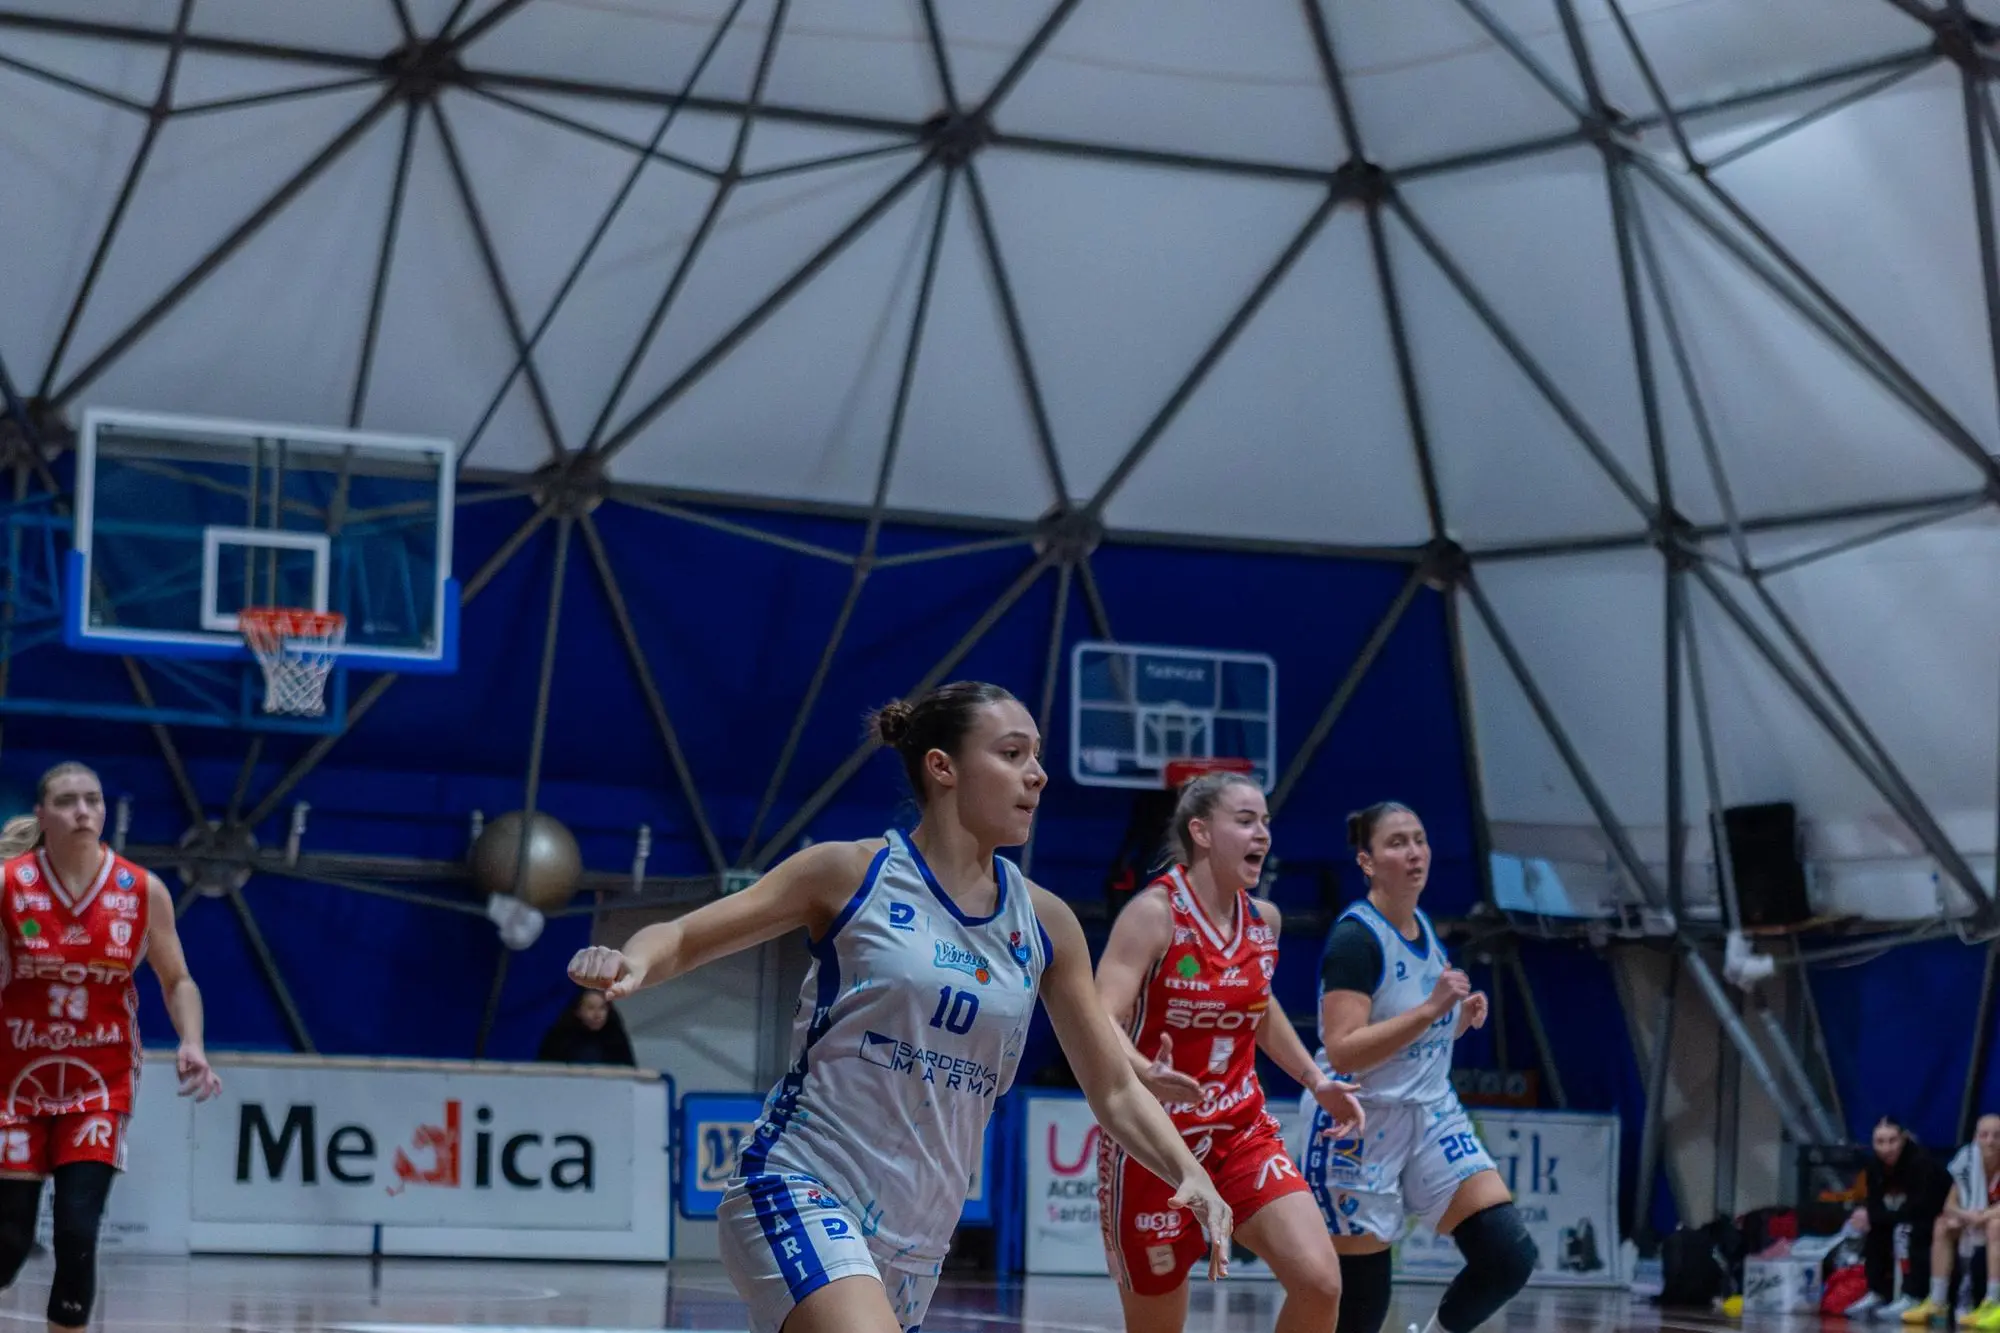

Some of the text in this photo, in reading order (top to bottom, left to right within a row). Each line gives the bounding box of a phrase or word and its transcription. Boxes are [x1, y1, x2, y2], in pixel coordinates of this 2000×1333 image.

[935, 938, 990, 969] Virtus
[929, 985, 980, 1036] 10
[1165, 1009, 1266, 1031] SCOT
[1168, 998, 1226, 1011] GRUPPO
[893, 1057, 994, 1098] MARMI
[897, 1041, 999, 1085] SARDEGNA
[236, 1099, 595, 1196] Medica
[1146, 1243, 1177, 1275] 5
